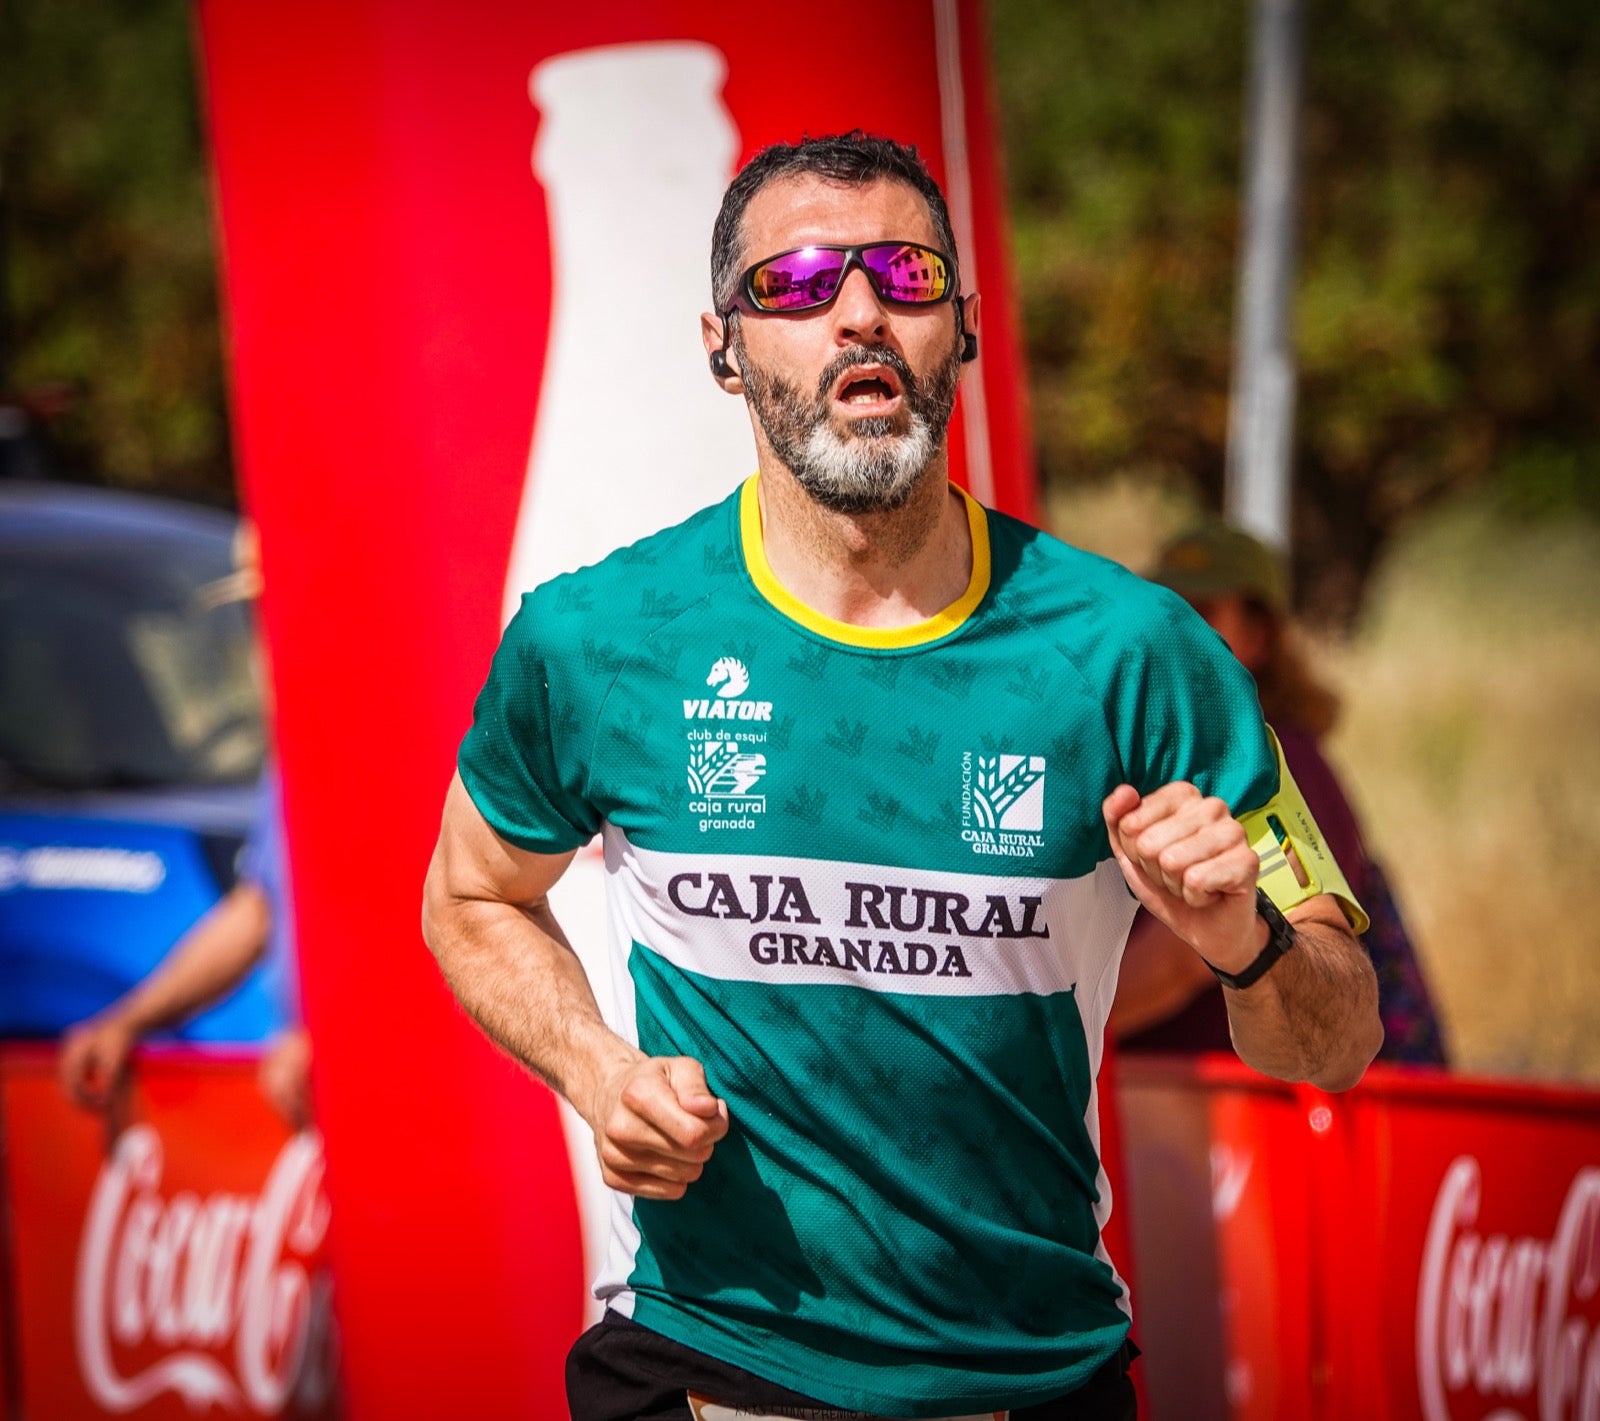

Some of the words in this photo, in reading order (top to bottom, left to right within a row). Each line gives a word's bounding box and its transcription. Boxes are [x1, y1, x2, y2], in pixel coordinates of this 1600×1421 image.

[683, 699, 773, 721] VIATOR
[687, 729, 712, 741] club
[716, 729, 731, 741] de
[735, 731, 767, 744] esquí
[961, 751, 972, 827] FUNDACIÓN
[689, 798, 722, 816] caja
[728, 797, 766, 813] rural
[699, 815, 755, 832] granada
[961, 829, 996, 844] CAJA
[999, 832, 1045, 847] RURAL
[973, 843, 1034, 857] GRANADA
[667, 872, 821, 924] CAJA
[845, 881, 1050, 939] RURAL
[749, 931, 972, 977] GRANADA
